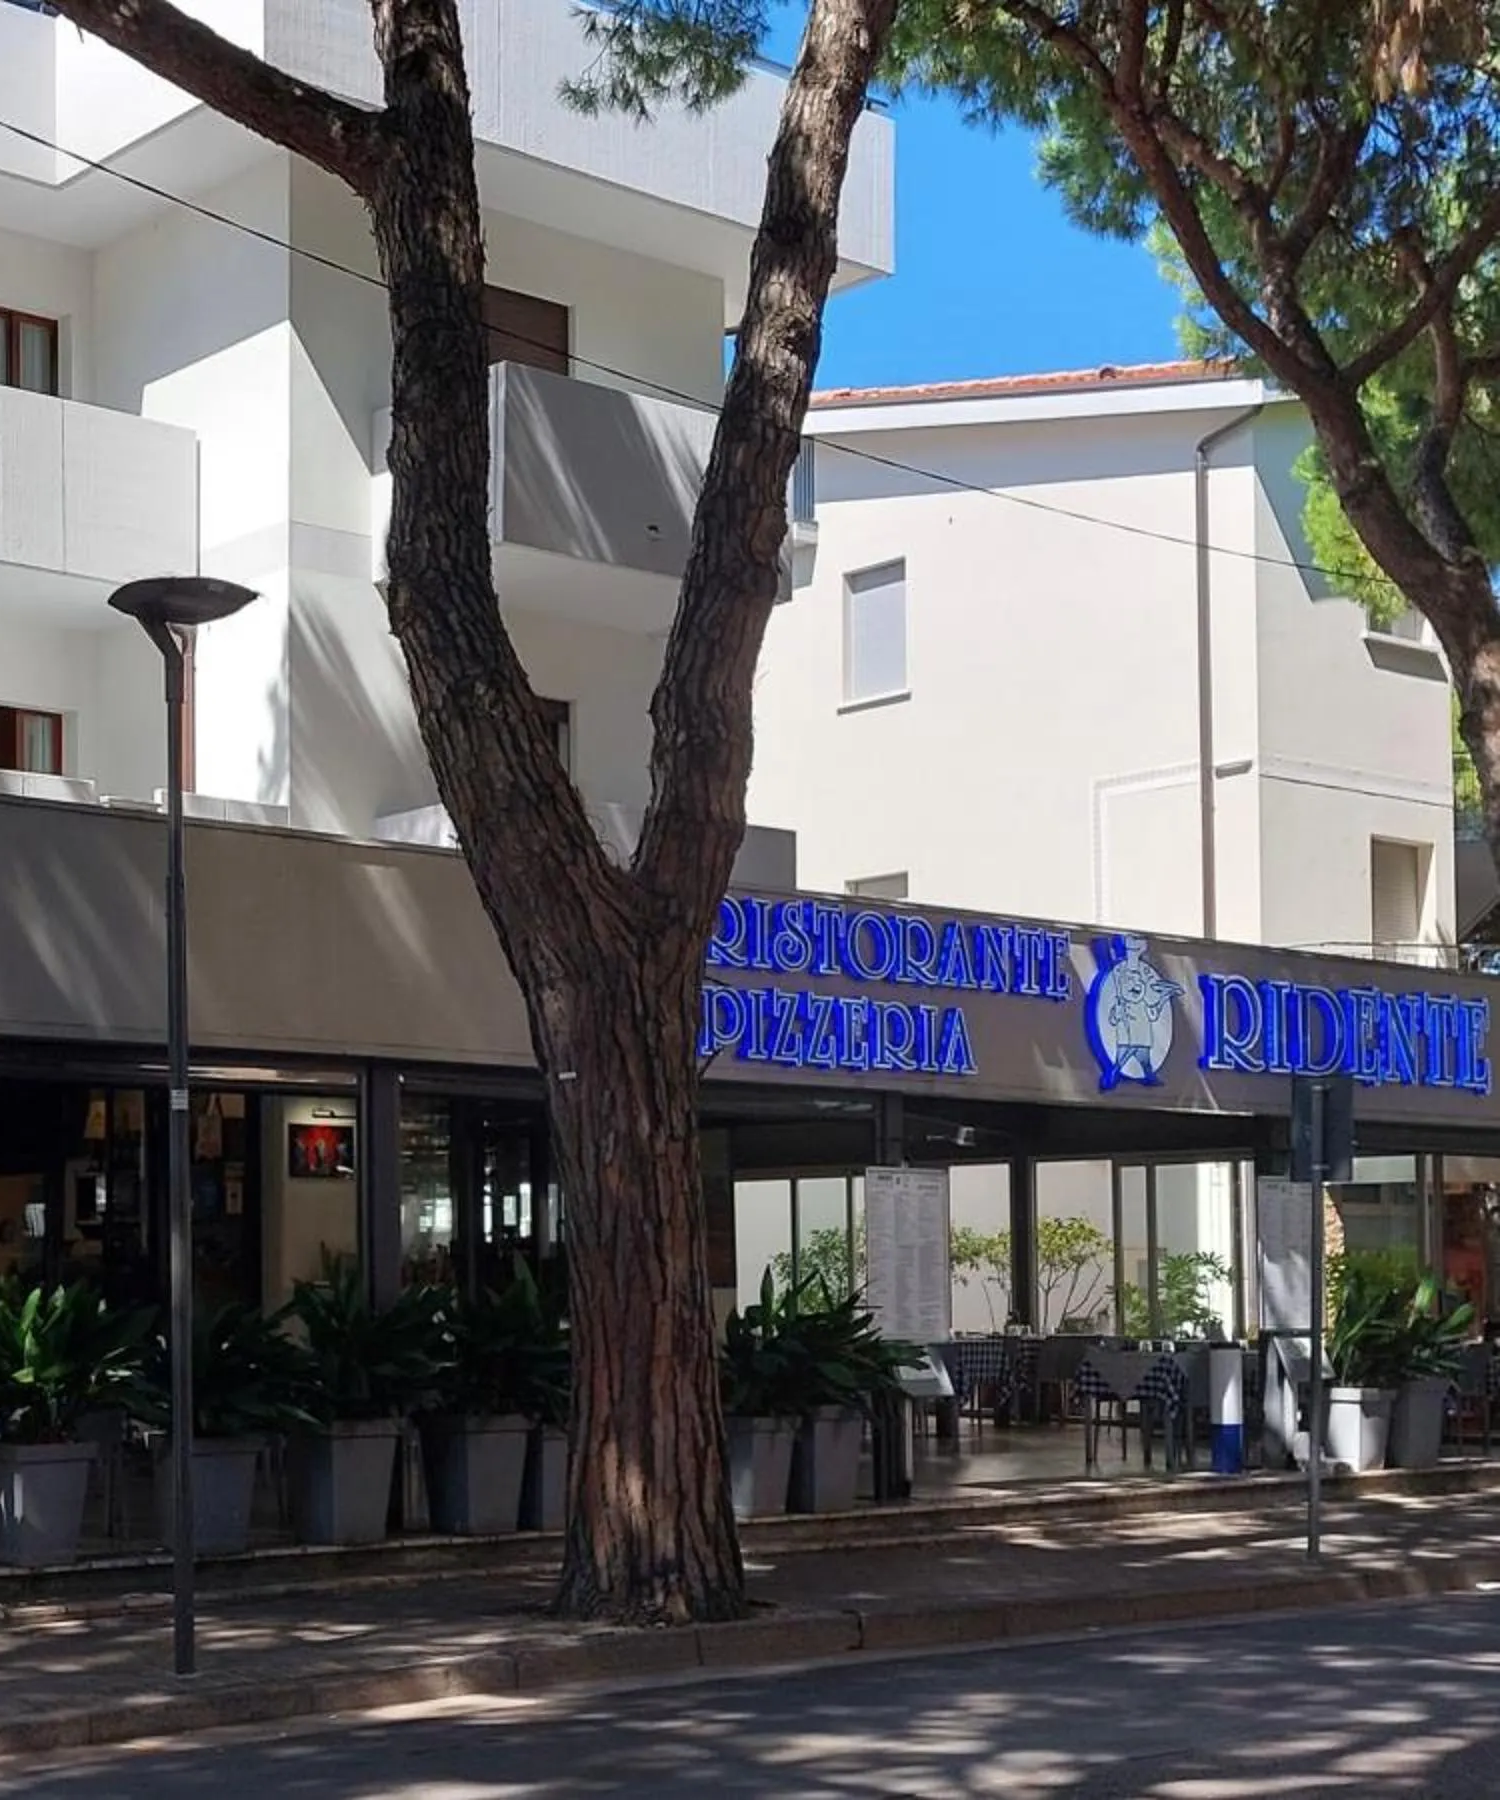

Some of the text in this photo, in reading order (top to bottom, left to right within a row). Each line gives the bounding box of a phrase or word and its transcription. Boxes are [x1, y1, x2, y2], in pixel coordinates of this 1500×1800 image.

[704, 895, 1072, 1000] RISTORANTE
[699, 983, 978, 1076] PIZZERIA
[1198, 973, 1491, 1097] RIDENTE
